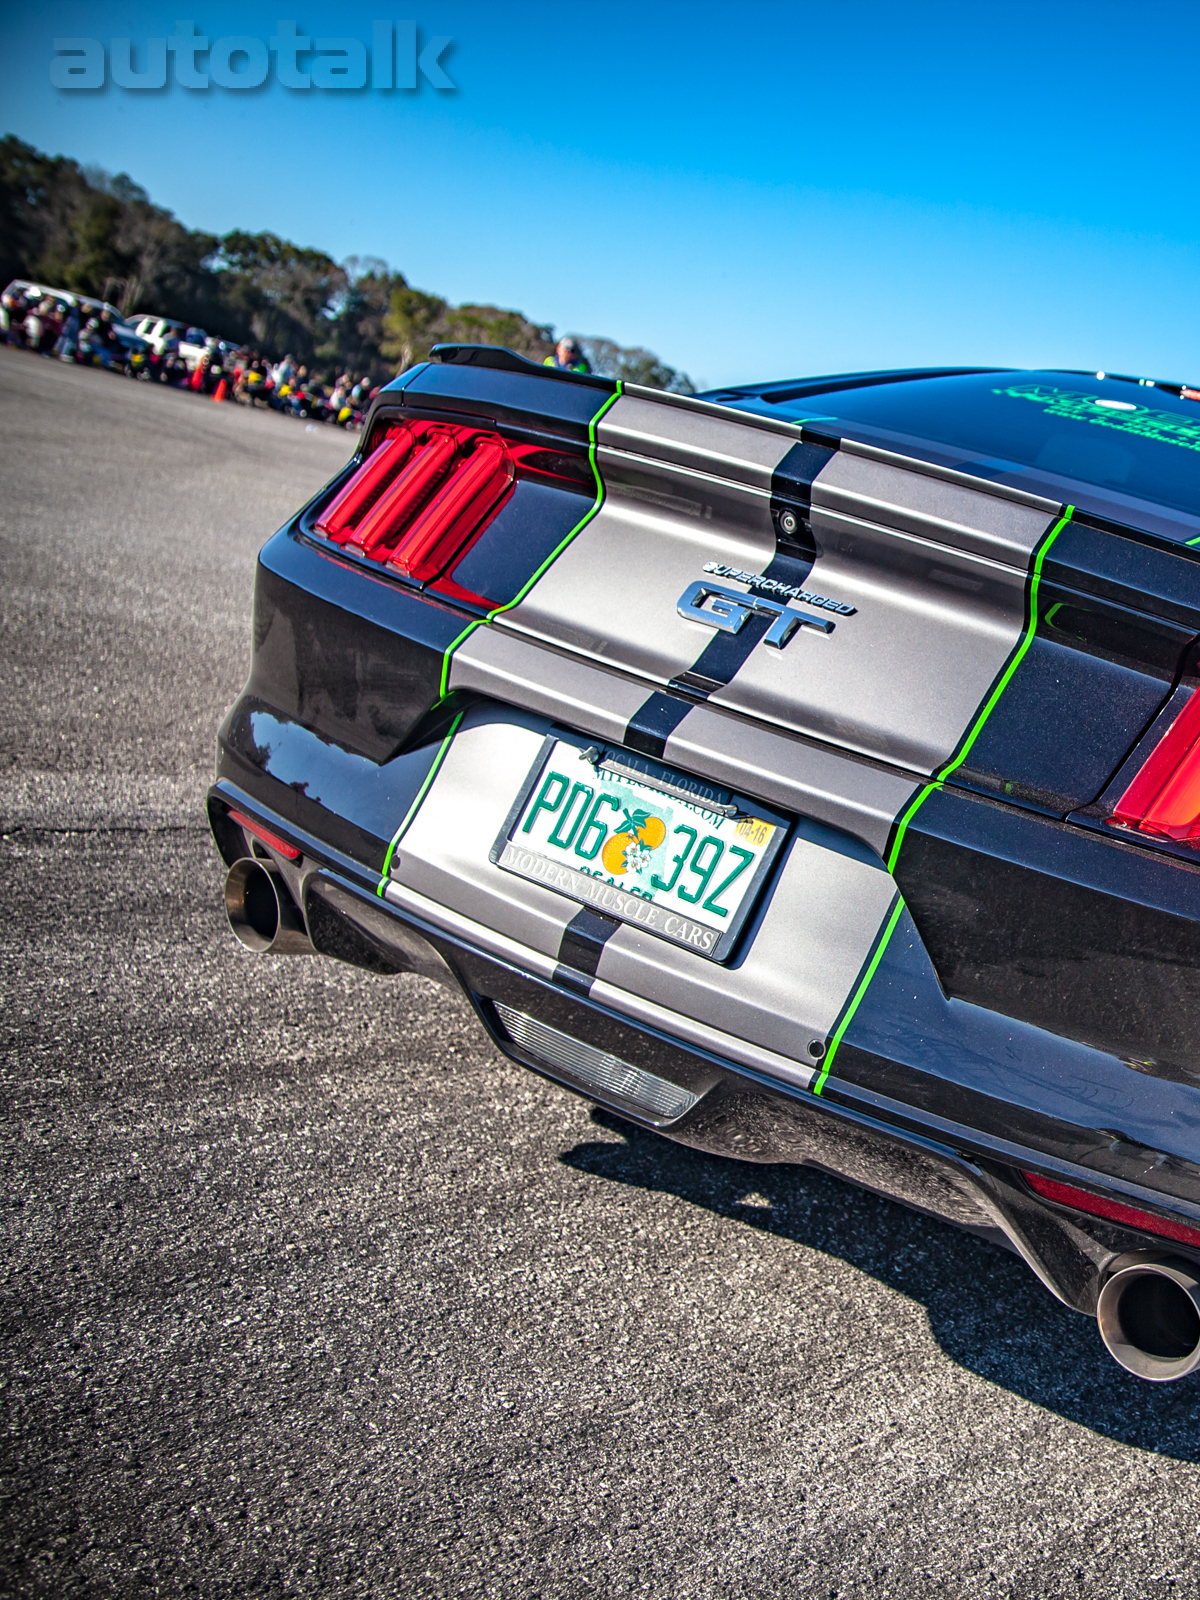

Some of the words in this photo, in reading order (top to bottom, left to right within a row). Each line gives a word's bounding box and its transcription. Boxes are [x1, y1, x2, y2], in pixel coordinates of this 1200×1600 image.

[677, 580, 836, 649] GT
[702, 561, 858, 616] SUPERCHARGED
[604, 750, 651, 779] OCALA
[658, 770, 723, 806] FLORIDA
[522, 769, 620, 861] PD6
[651, 824, 755, 917] 39Z
[503, 848, 584, 894] MODERN
[584, 881, 660, 926] MUSCLE
[664, 916, 715, 950] CARS
